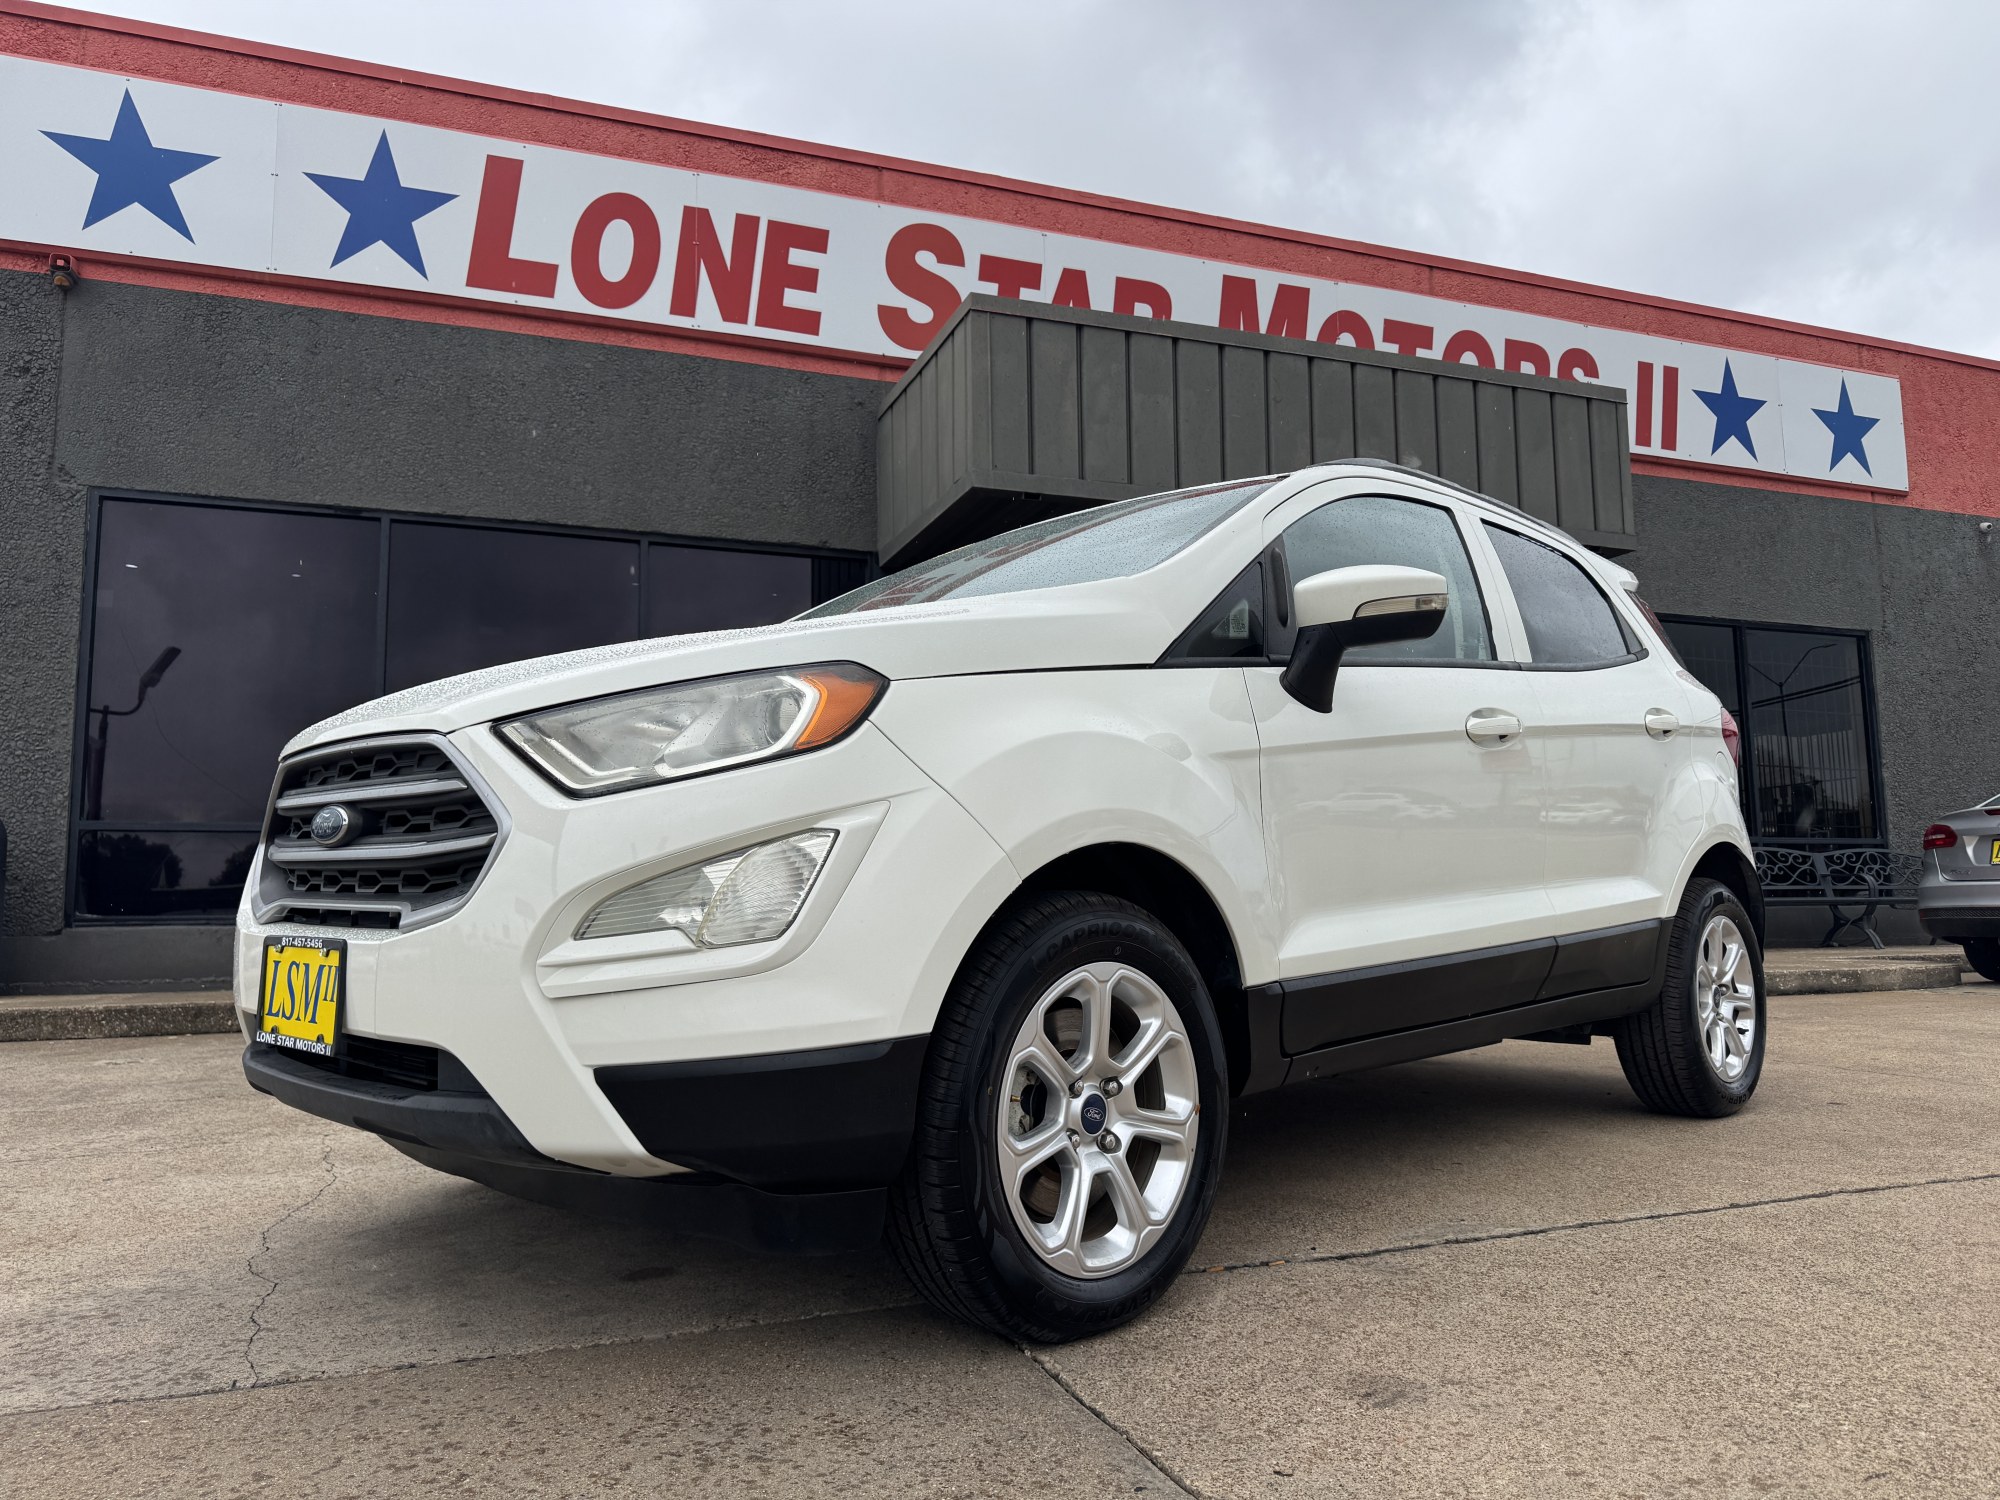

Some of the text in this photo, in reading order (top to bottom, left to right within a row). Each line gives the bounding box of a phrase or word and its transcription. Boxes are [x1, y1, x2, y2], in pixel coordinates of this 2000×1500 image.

[465, 154, 830, 337] LONE
[1635, 361, 1679, 452] II
[281, 937, 323, 948] 817-457-5456
[256, 1031, 332, 1057] LONE STAR MOTORS II
[1087, 1108, 1102, 1120] Ford
